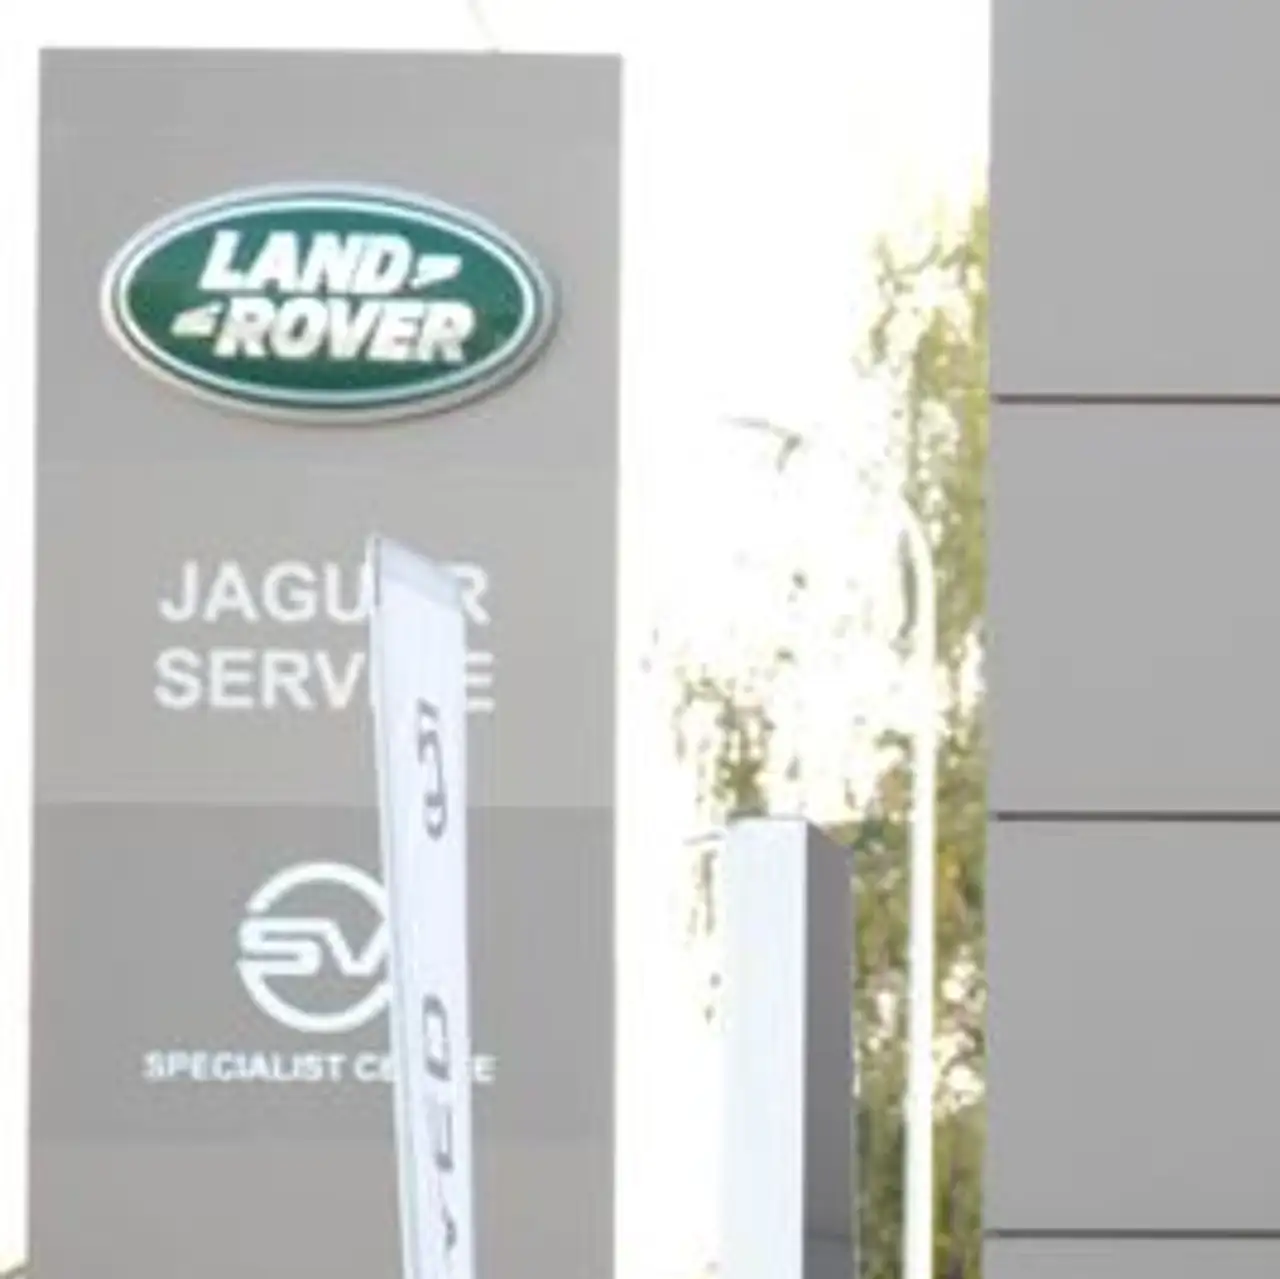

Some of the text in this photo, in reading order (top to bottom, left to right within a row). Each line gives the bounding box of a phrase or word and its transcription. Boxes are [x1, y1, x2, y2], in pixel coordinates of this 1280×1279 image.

[197, 229, 412, 295] LAND
[213, 297, 476, 362] ROVER
[157, 559, 492, 625] JAGUR
[153, 646, 496, 711] SERVE
[142, 1051, 497, 1082] SPECIALIST CEE
